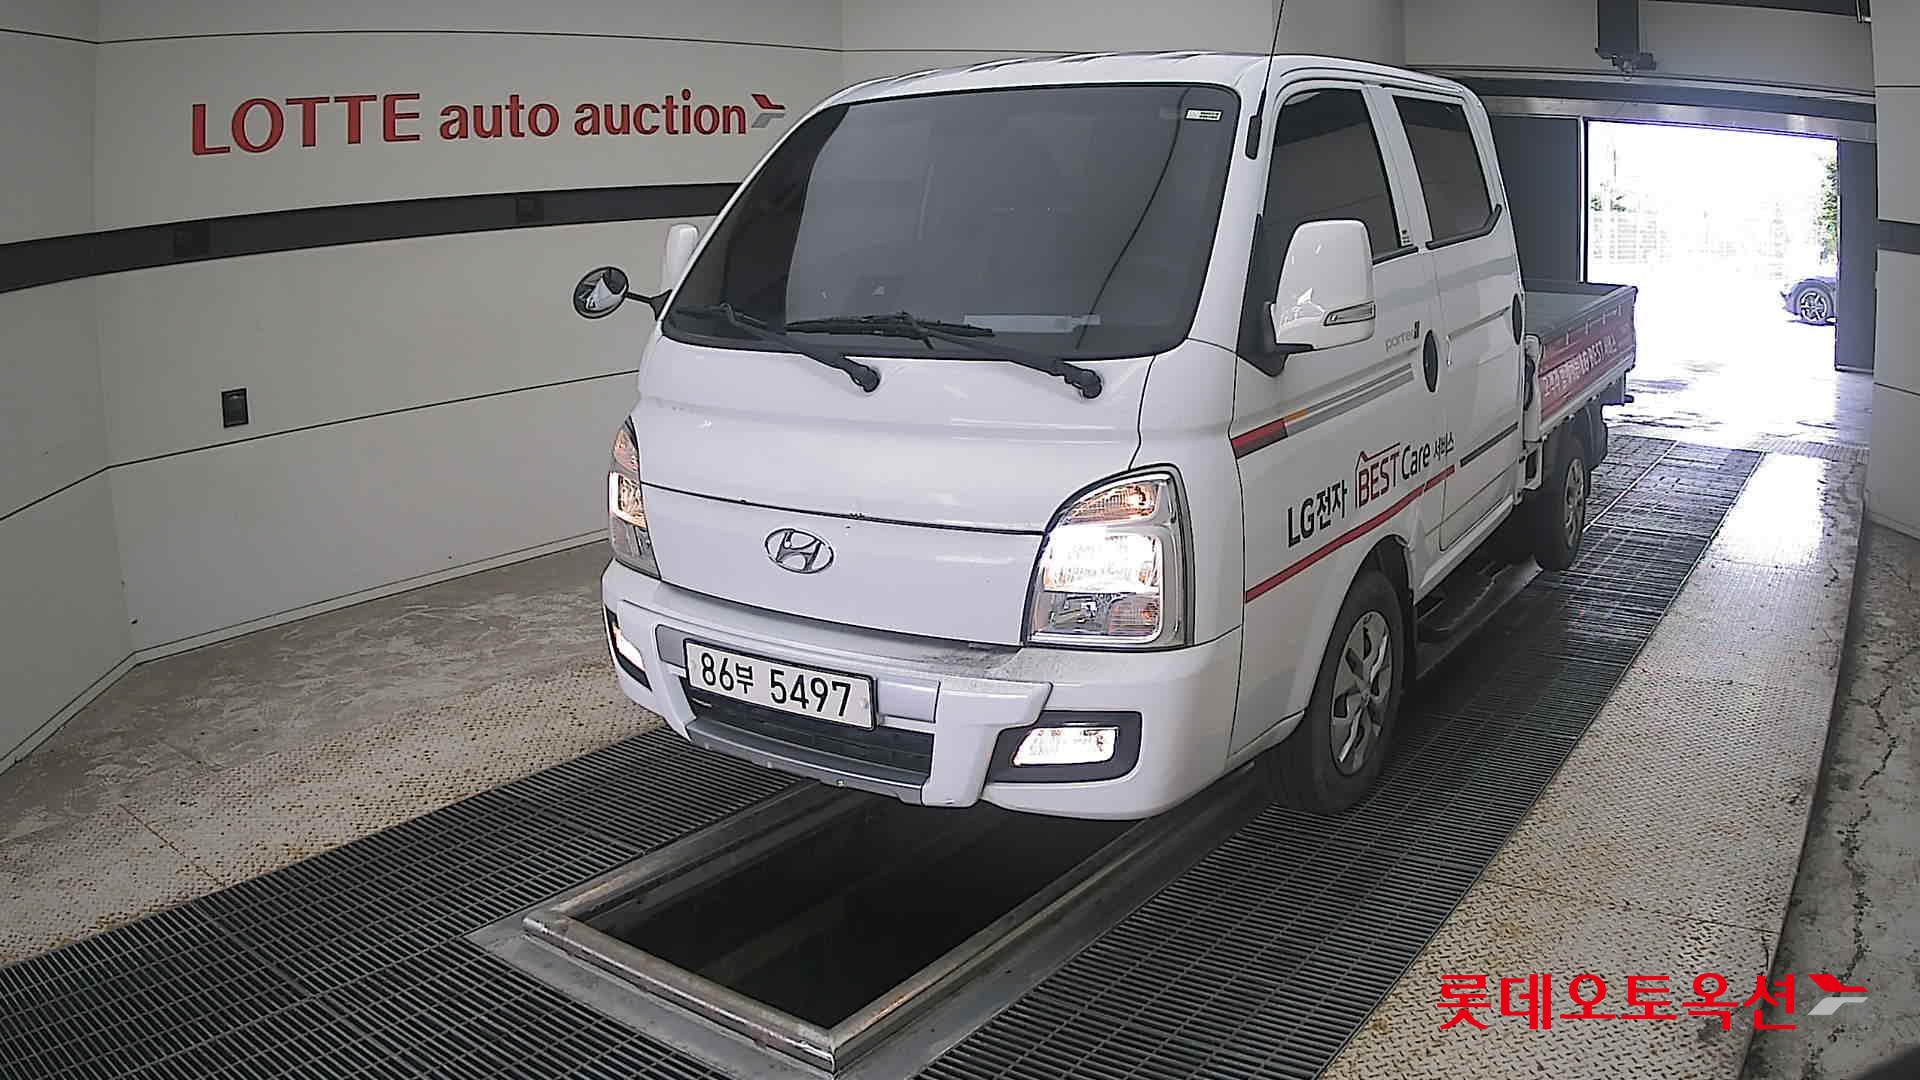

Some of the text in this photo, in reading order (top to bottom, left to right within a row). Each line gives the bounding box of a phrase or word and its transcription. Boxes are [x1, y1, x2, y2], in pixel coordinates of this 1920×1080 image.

[191, 88, 747, 155] LOTTE auto auction
[1287, 479, 1348, 548] LG전자
[1357, 449, 1401, 508] BEST
[1401, 442, 1431, 480] Care
[700, 652, 851, 717] 86부 5497
